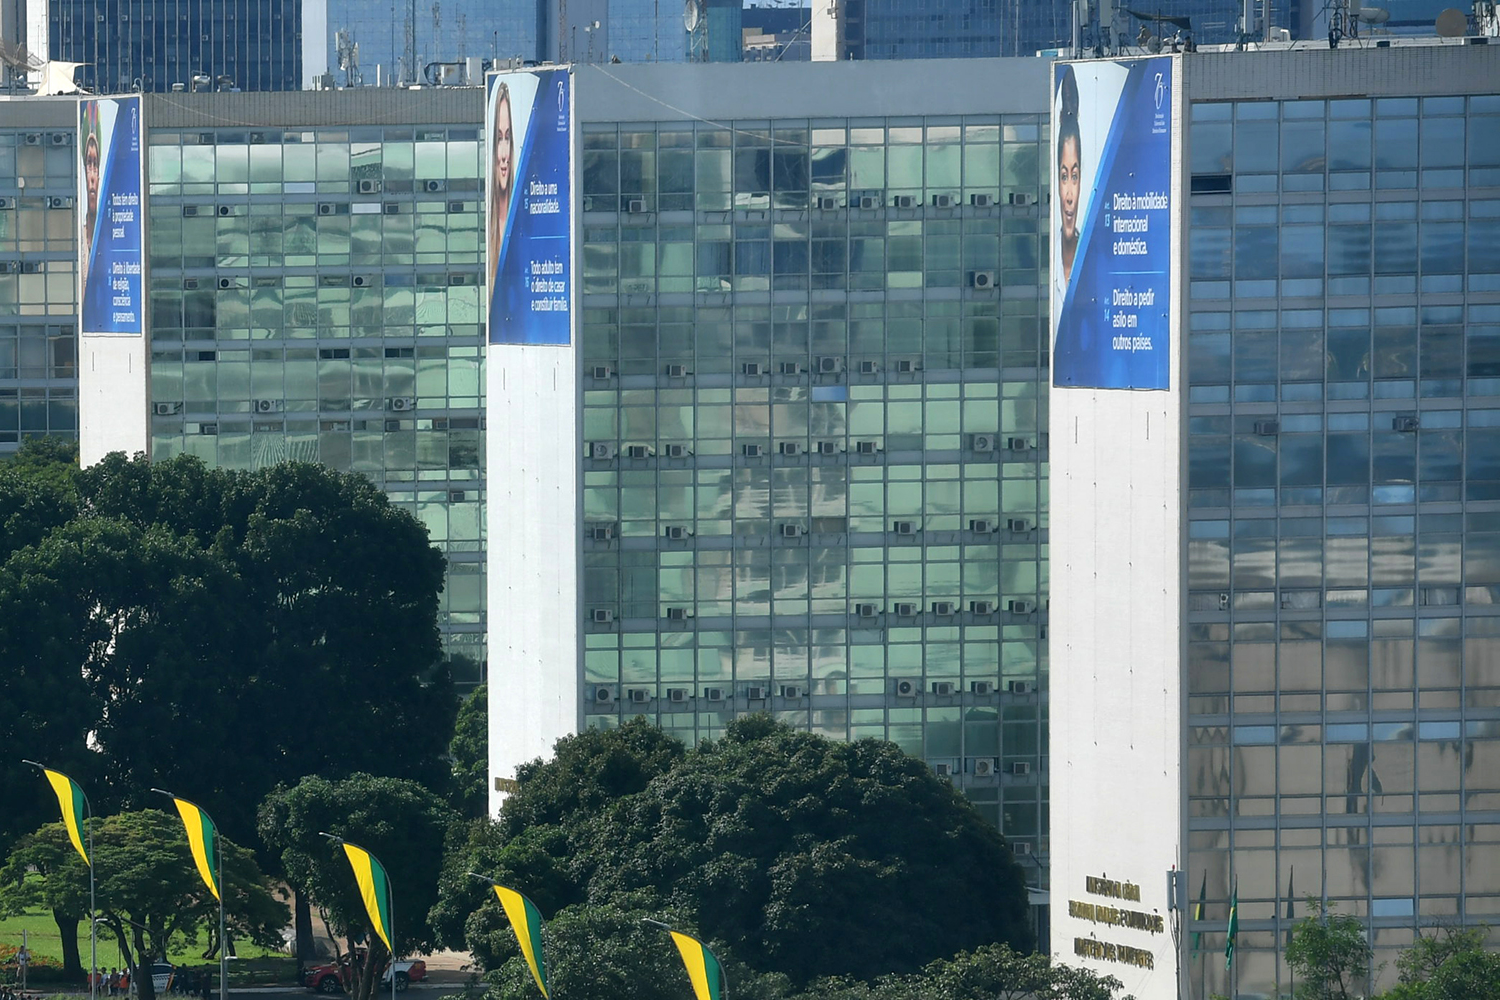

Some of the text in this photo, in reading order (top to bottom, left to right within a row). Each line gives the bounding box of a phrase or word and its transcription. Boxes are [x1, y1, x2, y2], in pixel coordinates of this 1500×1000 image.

[530, 180, 545, 195] Direito
[548, 183, 558, 195] uma
[1113, 193, 1132, 210] Direito
[1137, 191, 1168, 210] mobilidade
[1113, 214, 1148, 233] internacional
[1113, 241, 1118, 255] e
[530, 259, 564, 274] Todo adulto tem
[535, 276, 548, 293] direito
[548, 277, 554, 293] de
[554, 281, 565, 293] casar
[1113, 288, 1155, 310] Direito a pedir
[1113, 310, 1138, 328] asilo em
[1113, 333, 1132, 350] outros
